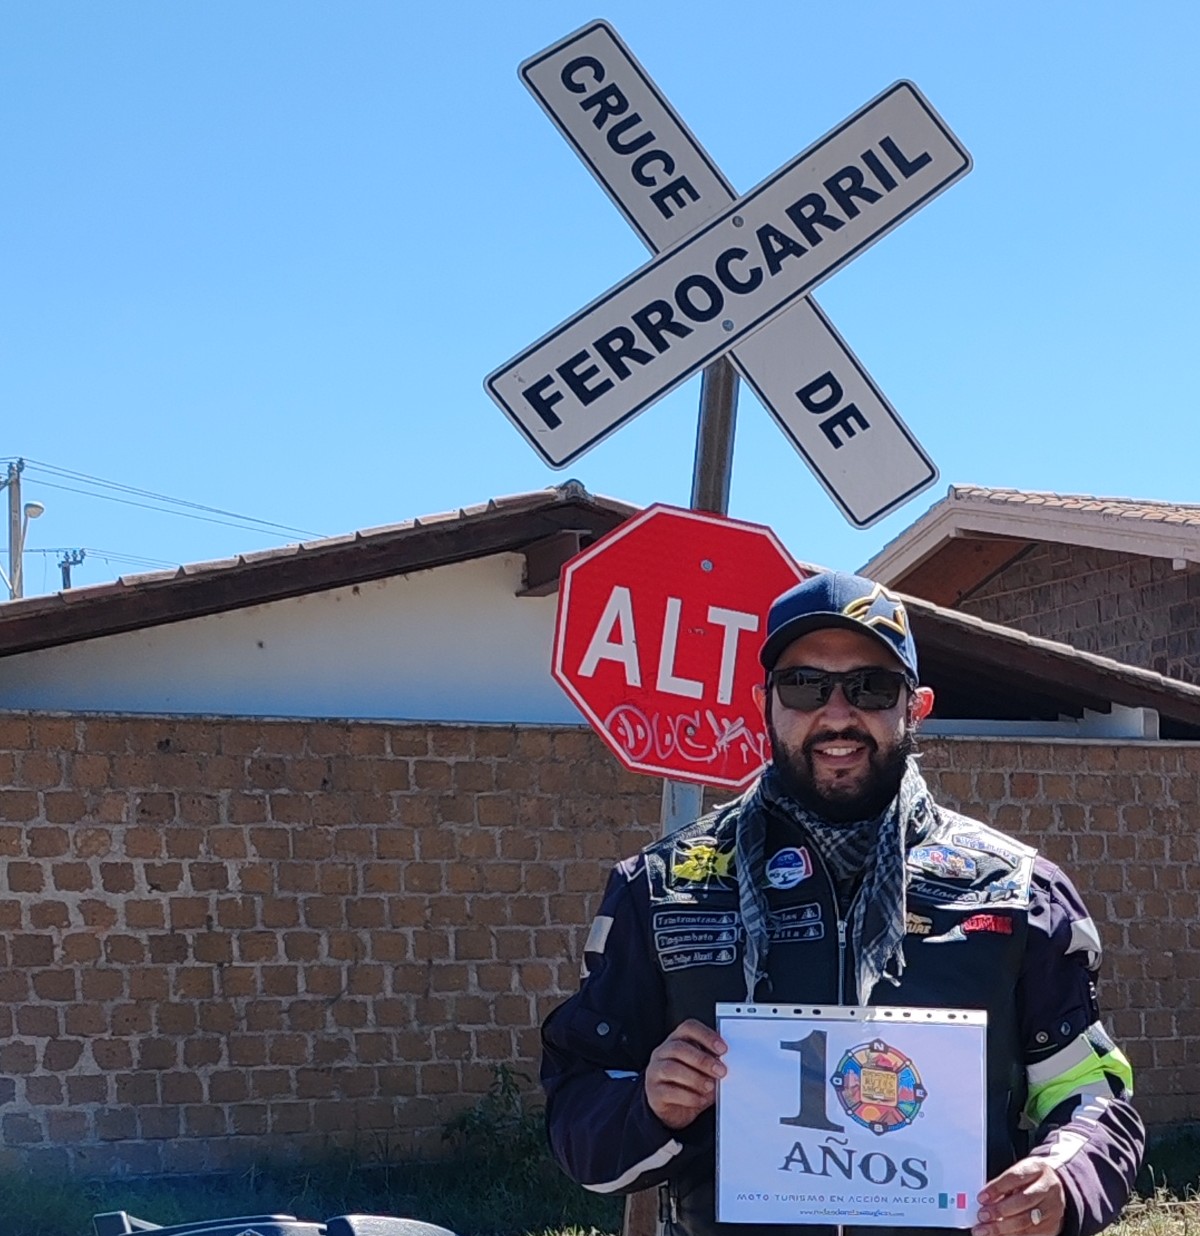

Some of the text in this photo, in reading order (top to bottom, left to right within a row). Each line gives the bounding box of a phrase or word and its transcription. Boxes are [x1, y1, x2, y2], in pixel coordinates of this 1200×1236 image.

[560, 56, 701, 220] CRUCE
[522, 135, 932, 430] FERROCARRIL
[795, 371, 871, 449] DE
[577, 585, 759, 705] ALT
[736, 1193, 770, 1202] MOTO
[775, 1194, 825, 1202] TURISMO
[829, 1194, 844, 1203] EN
[778, 1136, 929, 1190] AÑOS
